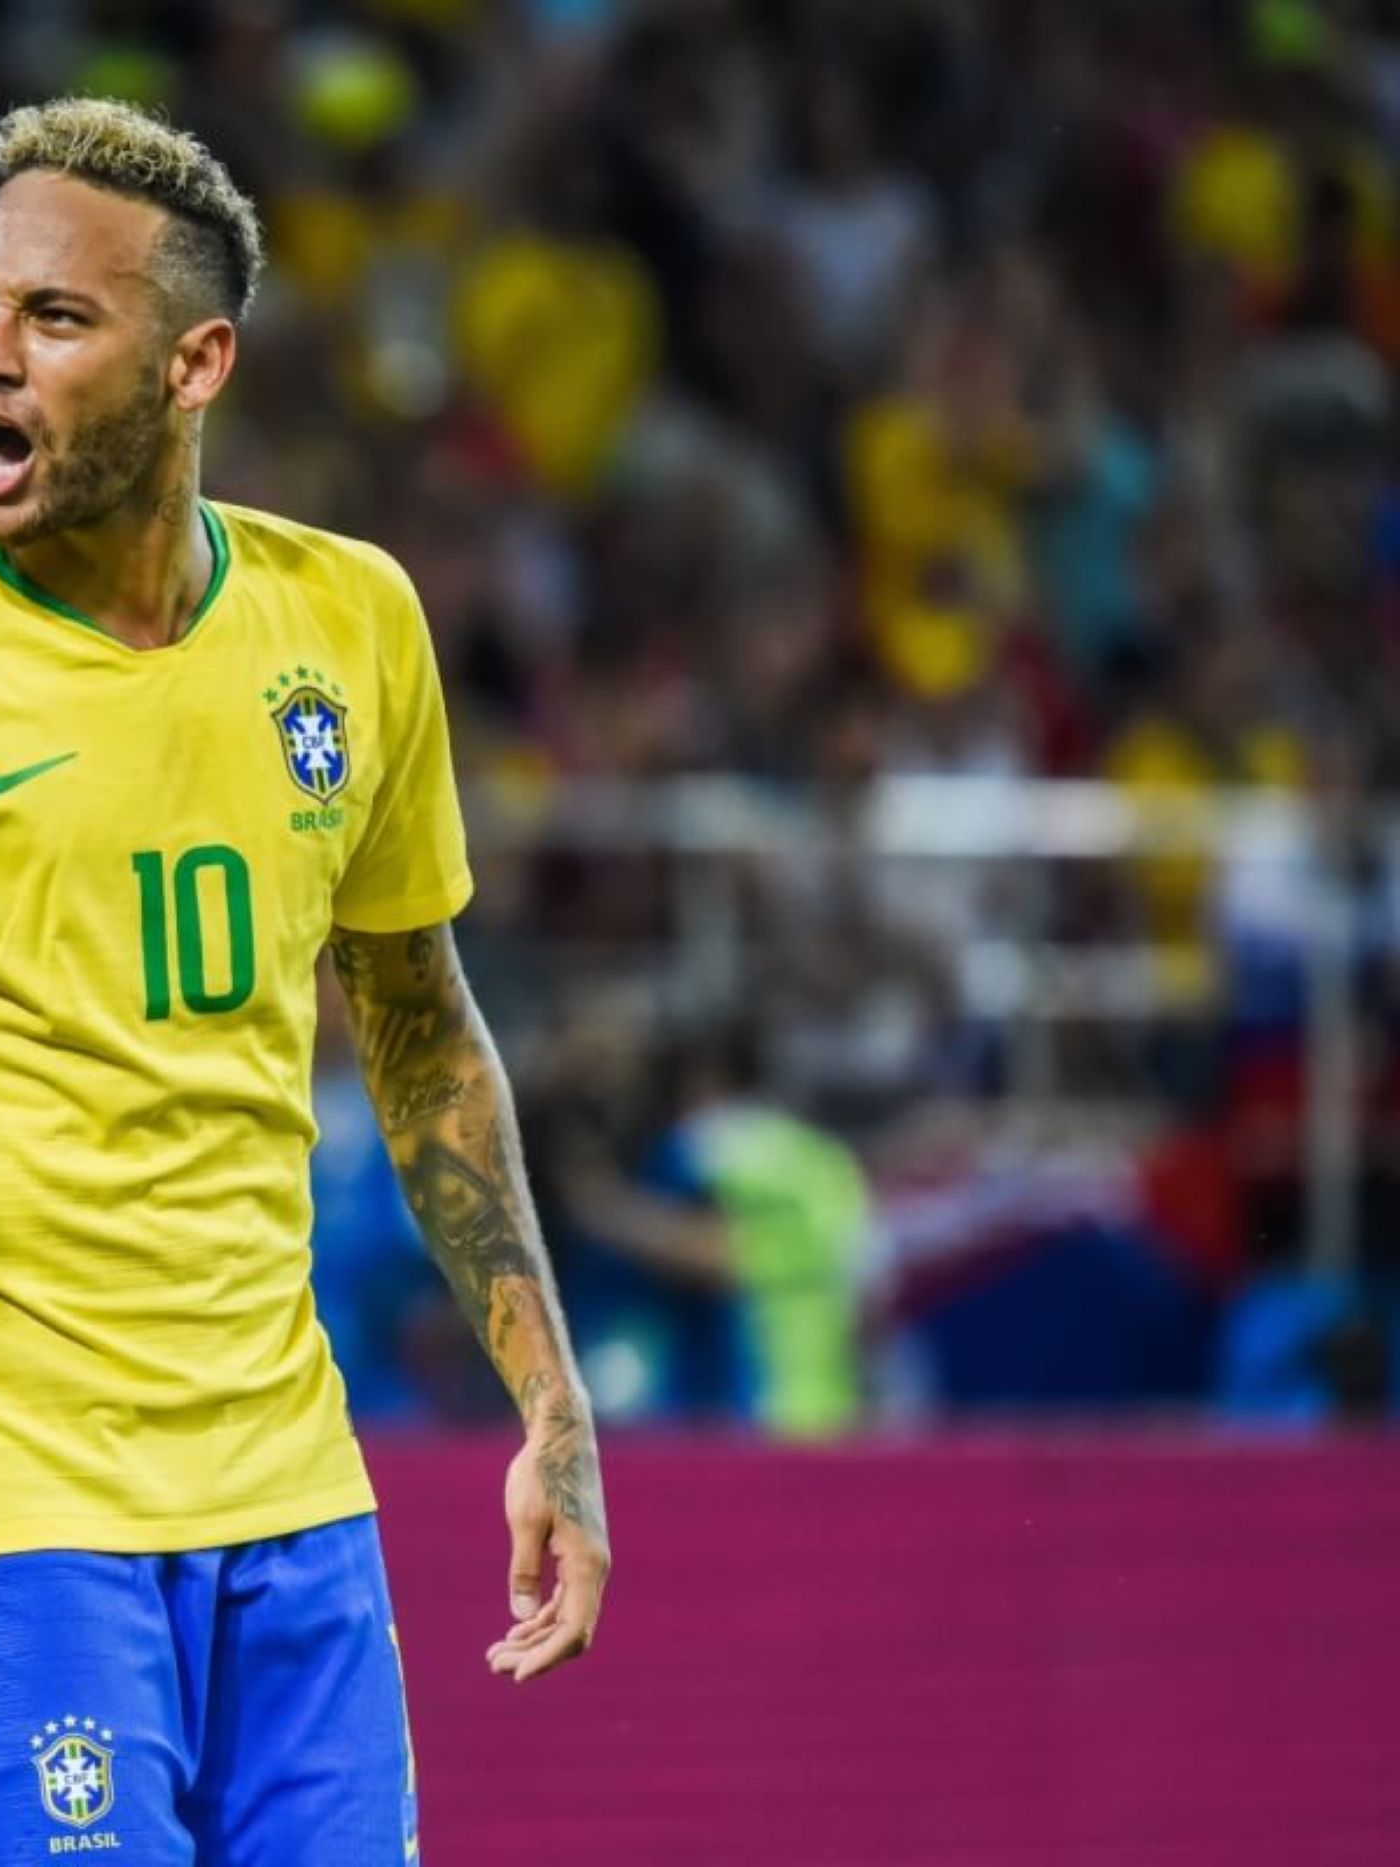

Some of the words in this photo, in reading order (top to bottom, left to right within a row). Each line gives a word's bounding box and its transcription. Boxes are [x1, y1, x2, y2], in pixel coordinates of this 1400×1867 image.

[290, 808, 344, 832] BRASI
[132, 844, 256, 1022] 10
[64, 1772, 89, 1785] CBF
[49, 1832, 122, 1854] BRASIL
